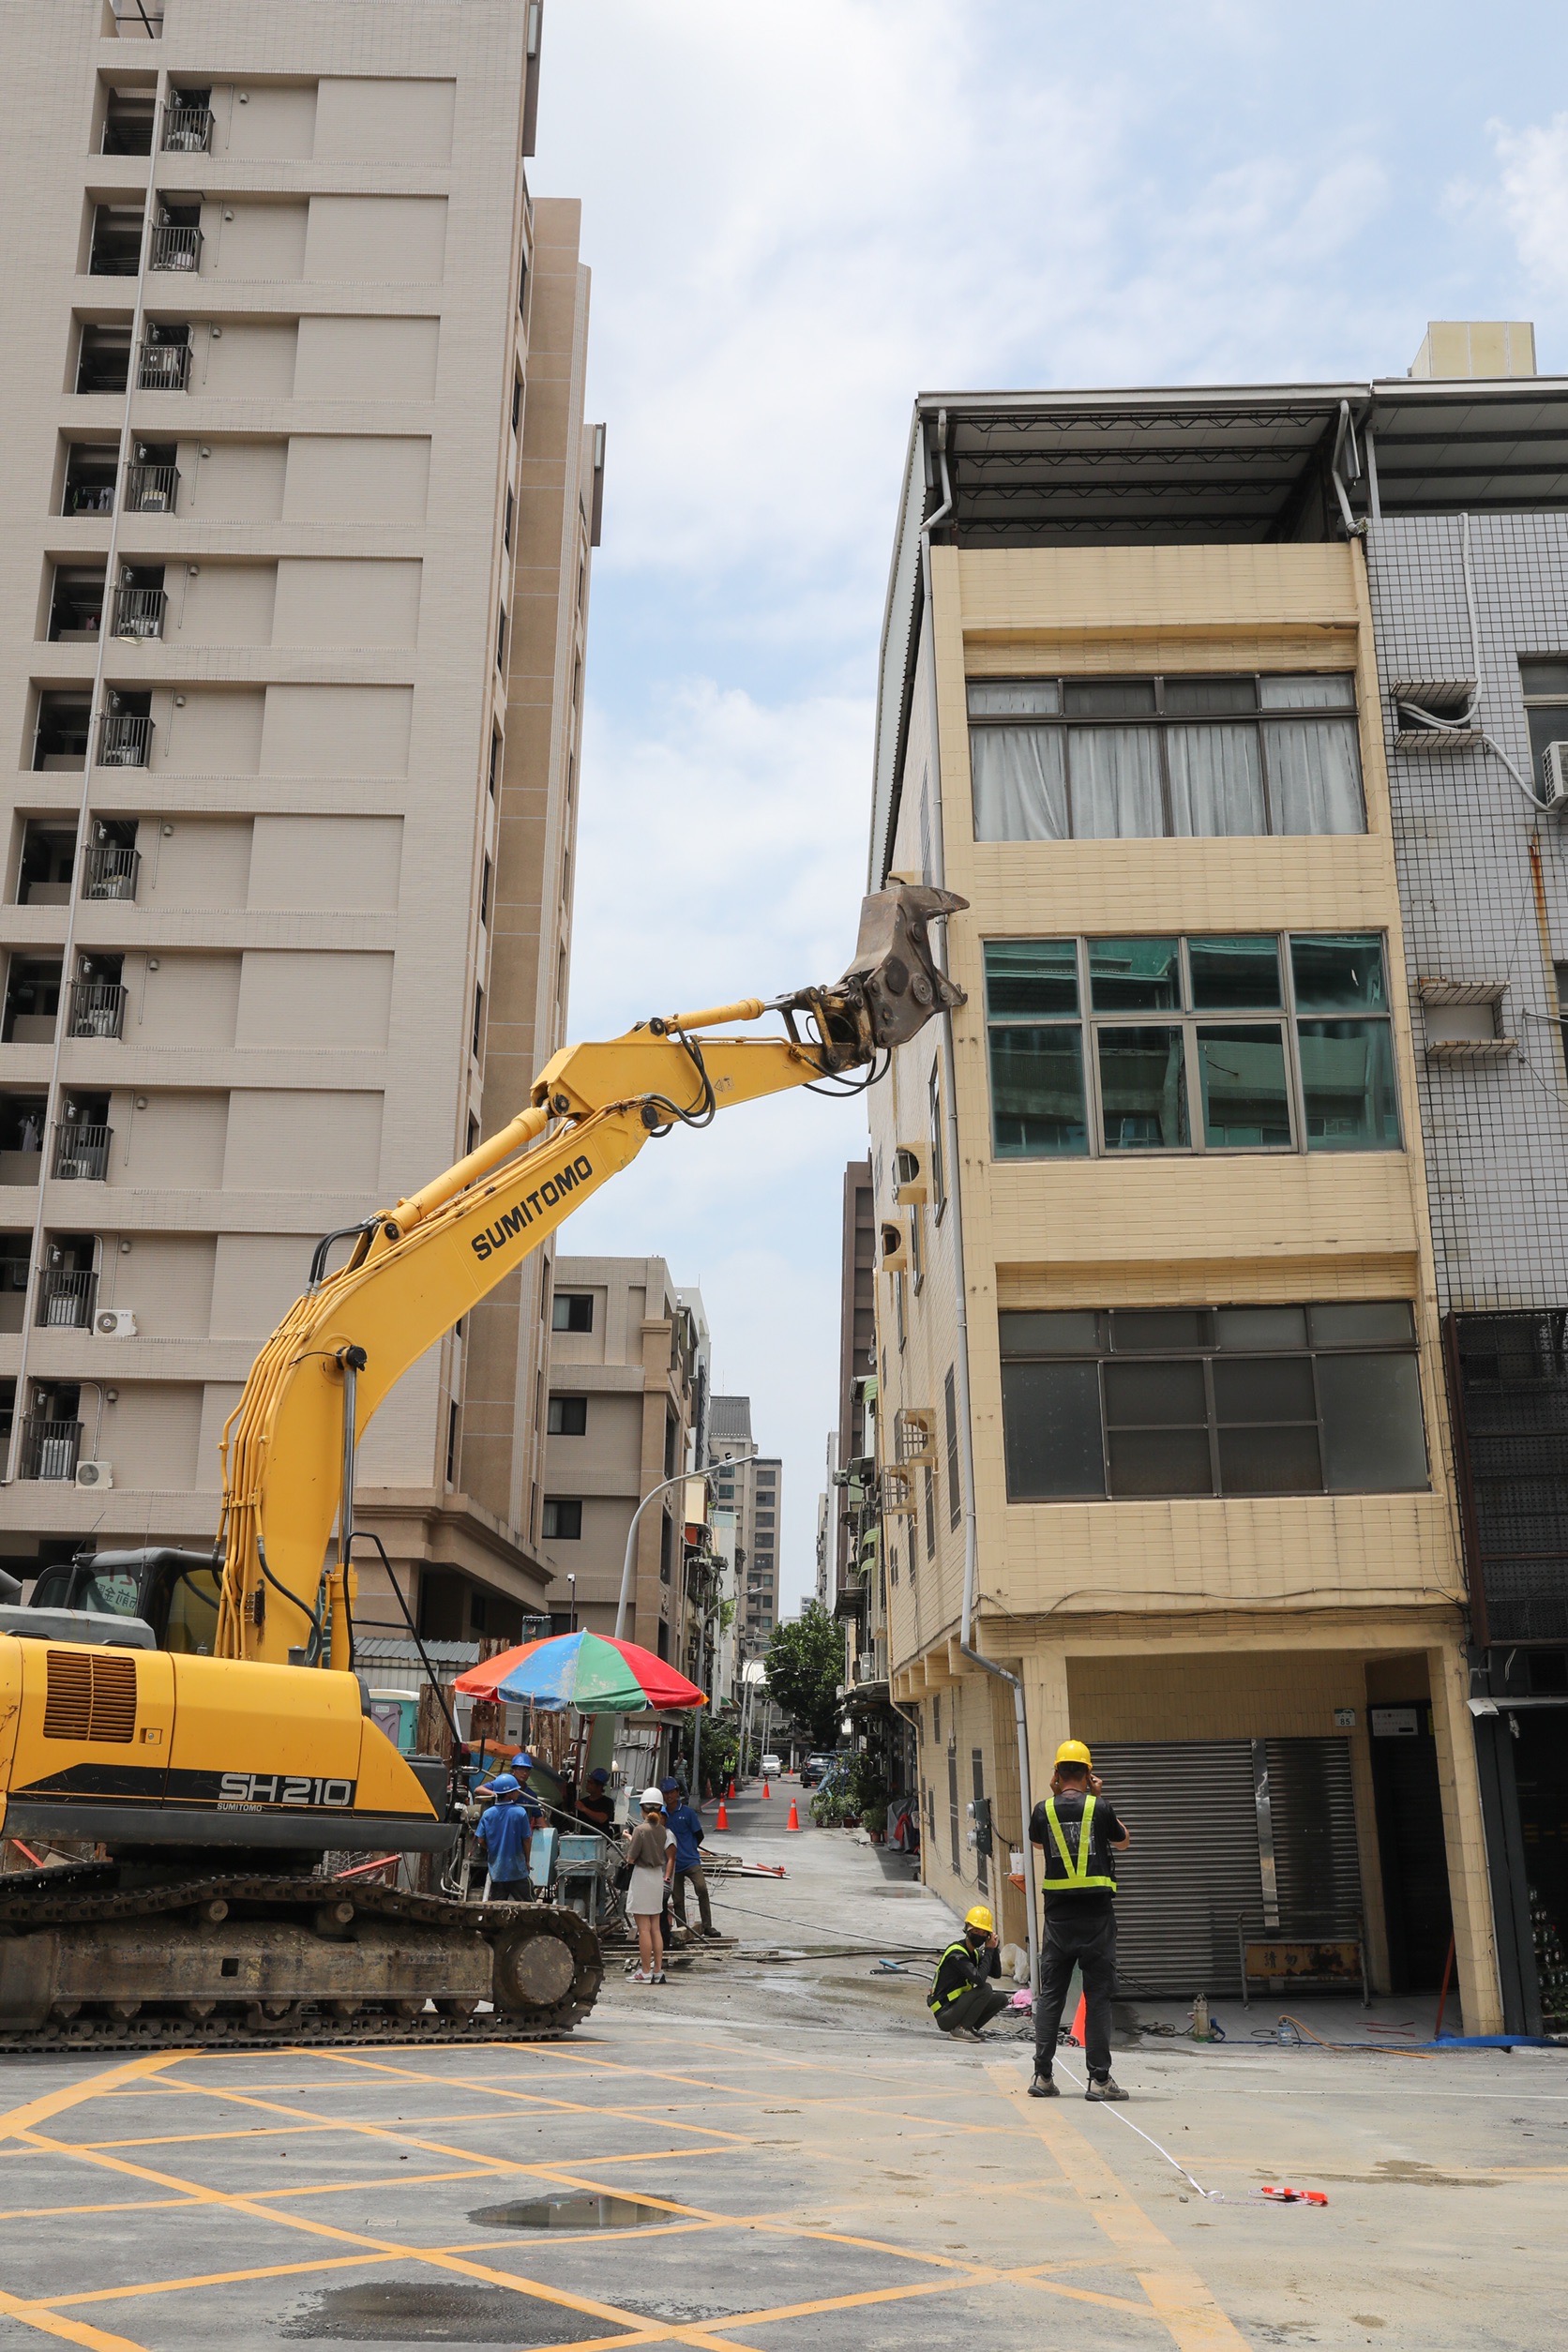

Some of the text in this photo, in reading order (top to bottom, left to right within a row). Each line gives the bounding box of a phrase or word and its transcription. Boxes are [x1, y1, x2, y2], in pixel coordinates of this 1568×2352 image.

[471, 1154, 593, 1261] SUMITOMO
[219, 1772, 352, 1806] SH210
[217, 1802, 263, 1812] SUMITOMO
